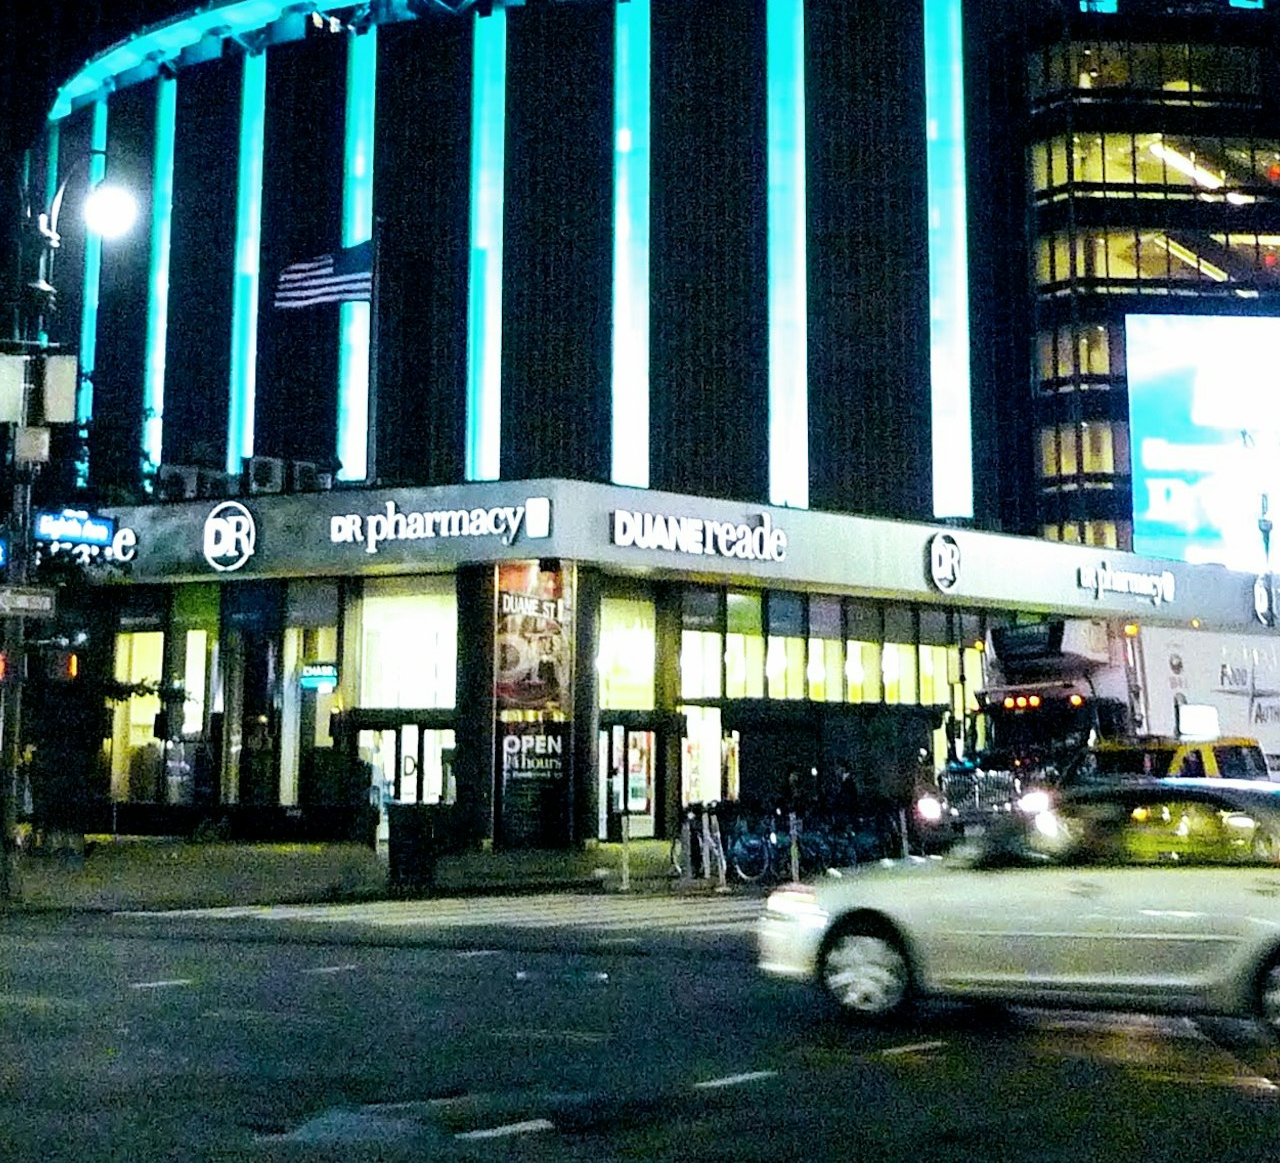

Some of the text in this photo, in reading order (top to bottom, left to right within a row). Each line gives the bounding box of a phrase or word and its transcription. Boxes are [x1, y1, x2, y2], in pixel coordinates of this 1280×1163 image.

[204, 514, 256, 557] DR
[331, 500, 525, 554] DR pharmacy
[503, 594, 539, 615] DUANE
[503, 734, 562, 754] OPEN
[521, 753, 562, 769] hours
